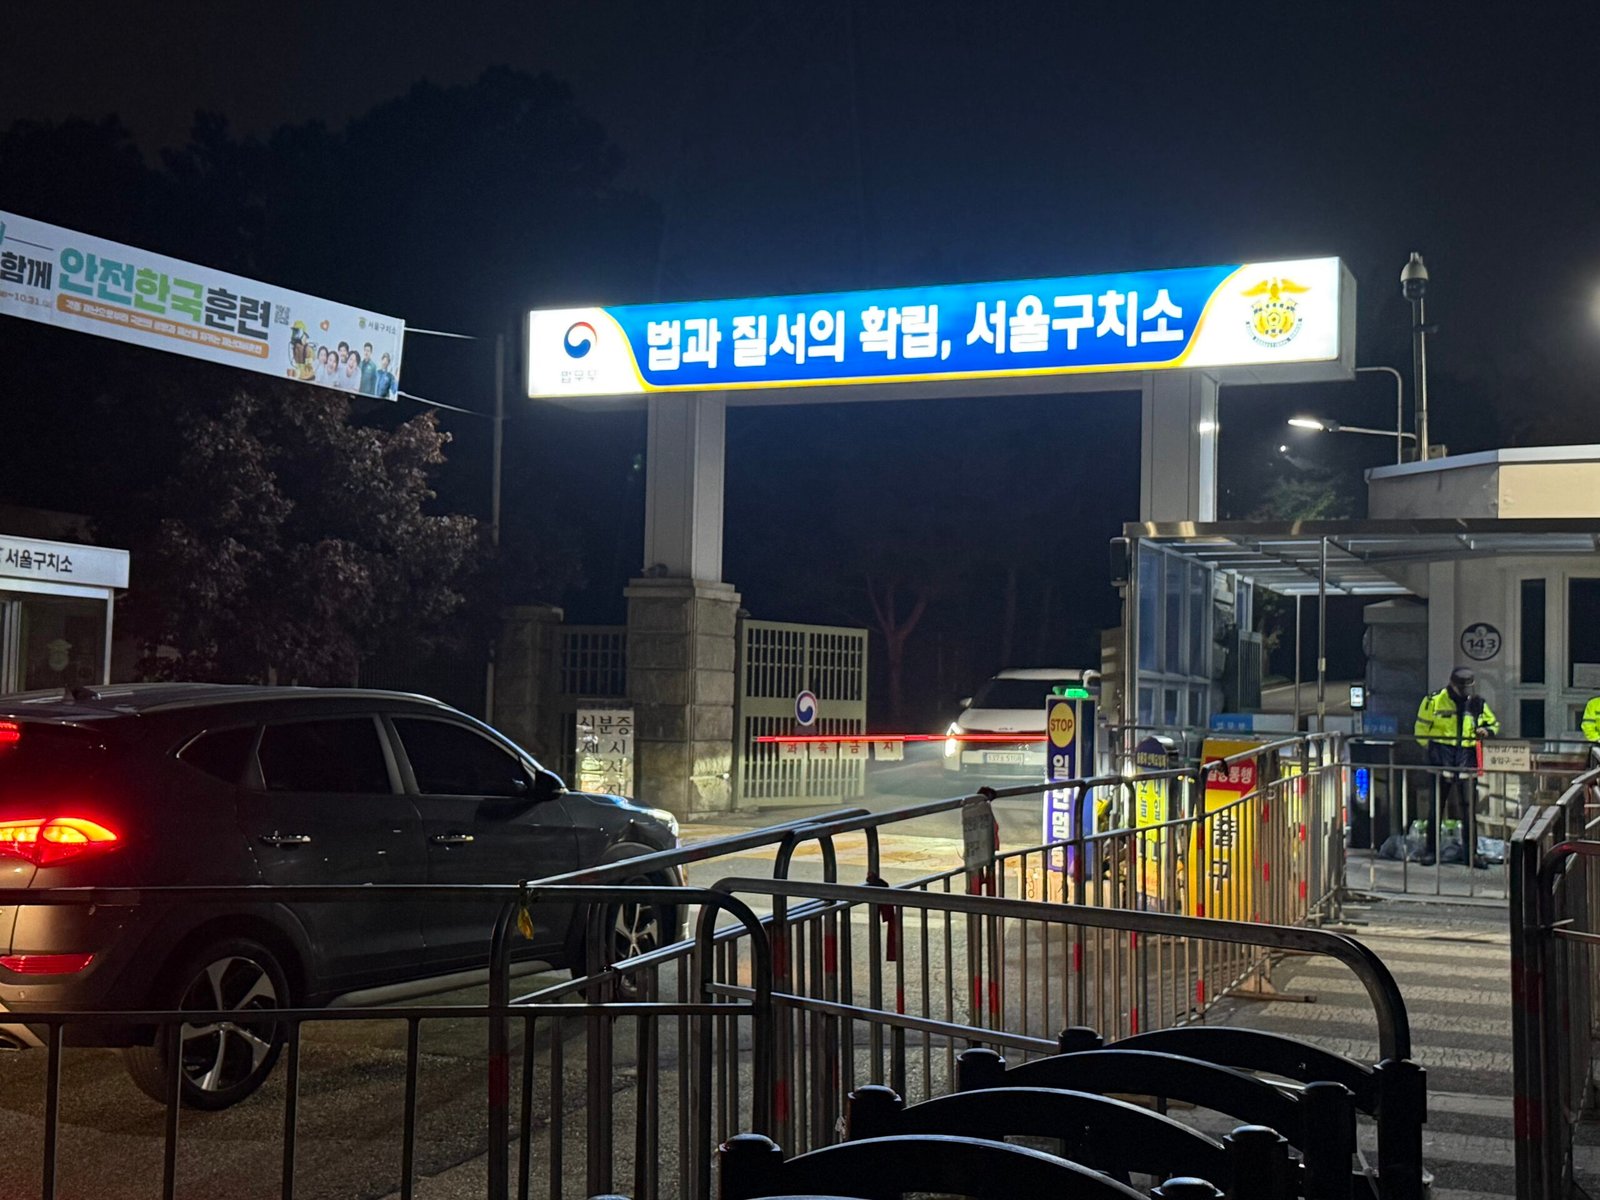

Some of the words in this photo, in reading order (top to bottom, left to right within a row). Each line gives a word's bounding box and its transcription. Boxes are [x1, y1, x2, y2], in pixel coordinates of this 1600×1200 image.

[0, 250, 52, 291] 함께
[647, 317, 721, 372] 법과
[732, 308, 845, 368] 질서의
[859, 303, 951, 362] 확립,
[966, 288, 1184, 354] 서울구치소
[5, 548, 73, 573] 서울구치소
[1466, 637, 1497, 650] 143
[580, 714, 633, 736] 신분증
[1050, 718, 1073, 733] STOP
